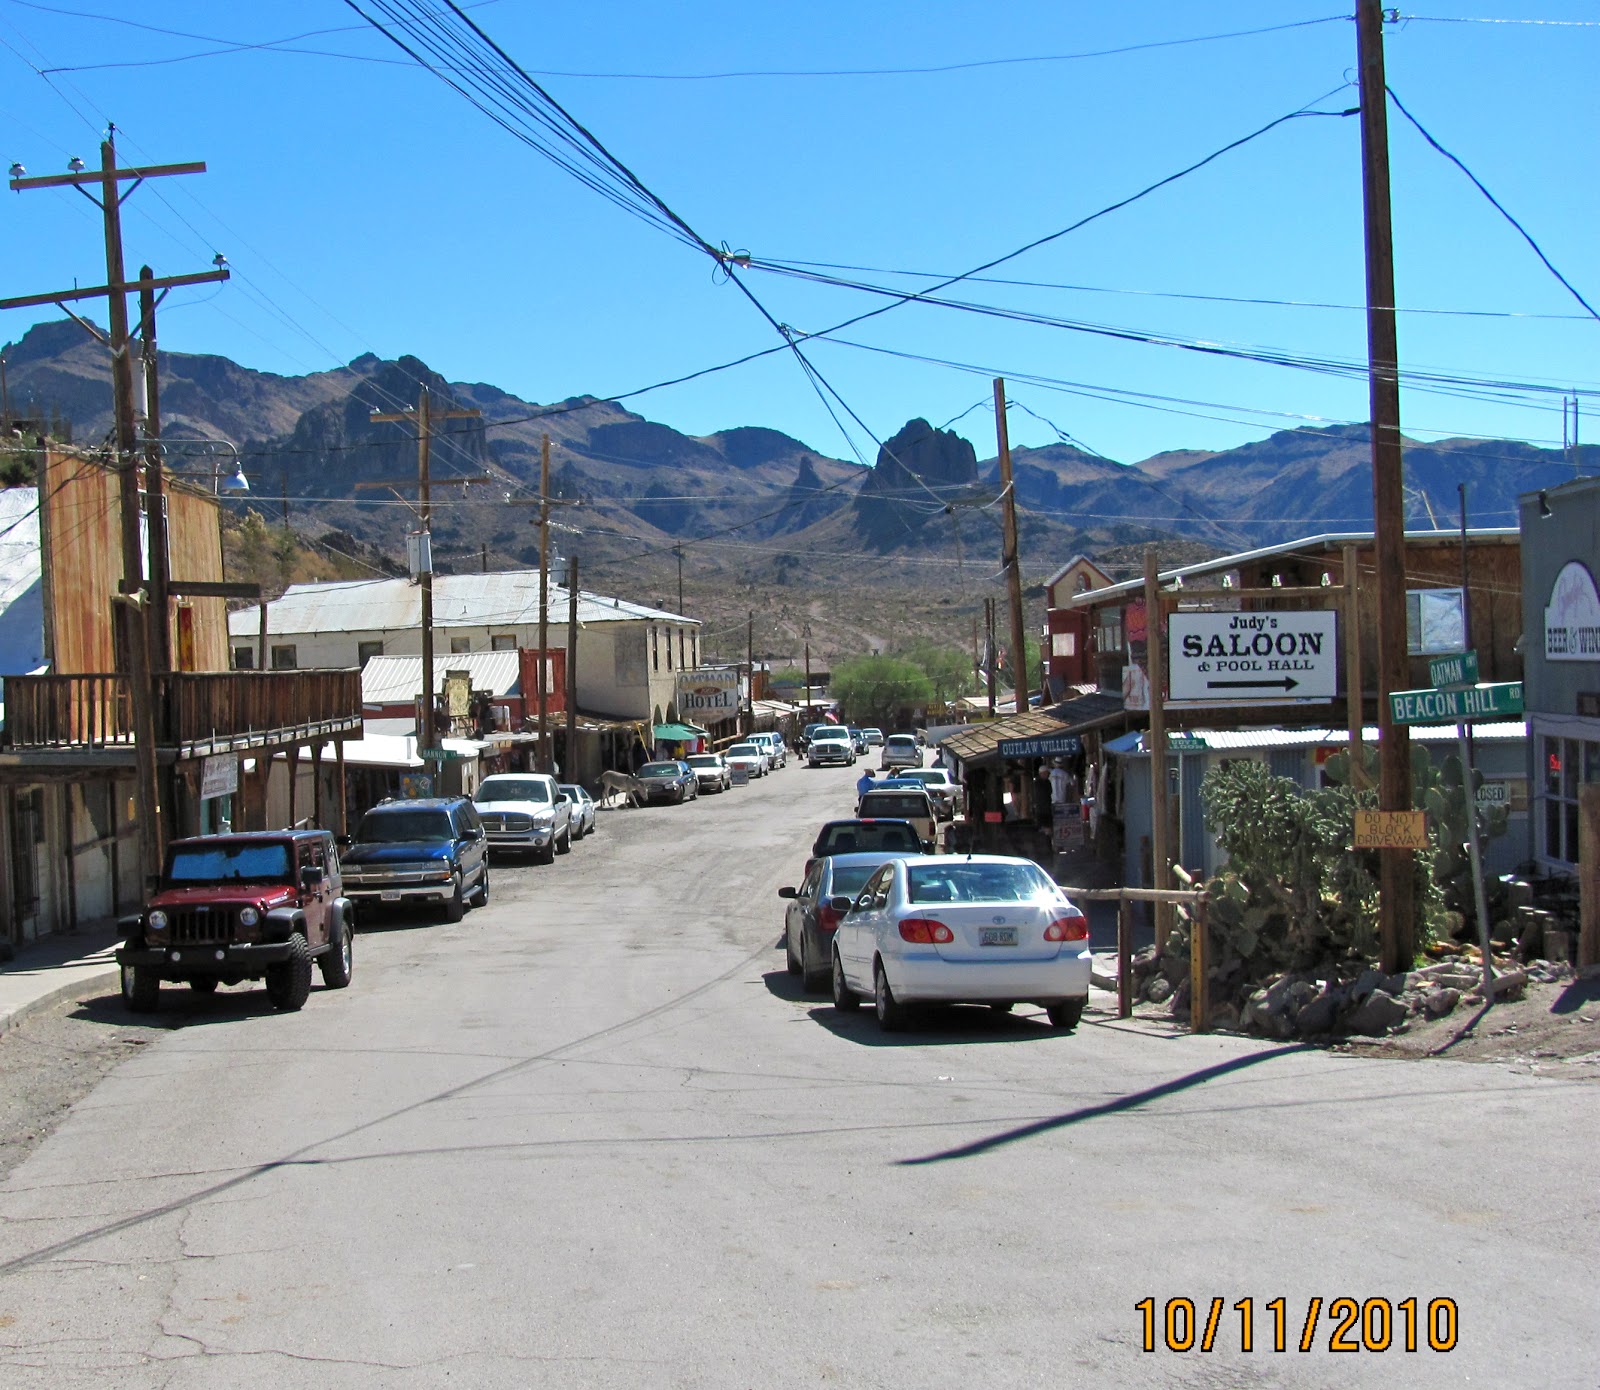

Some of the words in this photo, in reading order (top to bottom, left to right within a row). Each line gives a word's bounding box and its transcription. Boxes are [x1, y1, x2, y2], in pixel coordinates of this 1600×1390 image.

[1229, 615, 1278, 631] Judy's
[1182, 632, 1324, 658] SALOON
[1548, 627, 1568, 653] BEER
[1578, 627, 1600, 653] WIN
[1197, 661, 1211, 672] &
[1216, 660, 1262, 671] POOL
[1267, 659, 1315, 671] HALL
[1430, 659, 1462, 687] OATMAN
[684, 691, 733, 709] HOTEL
[1393, 693, 1457, 720] BEACON
[1464, 688, 1498, 714] HILL
[1509, 687, 1520, 699] RD
[1002, 741, 1039, 755] OUTLAW
[1040, 738, 1077, 753] WILLIE'S
[1364, 814, 1381, 825] DO
[1389, 813, 1419, 825] NOT
[1369, 824, 1411, 834] BLOCK
[1357, 834, 1423, 846] DRIVEWAY
